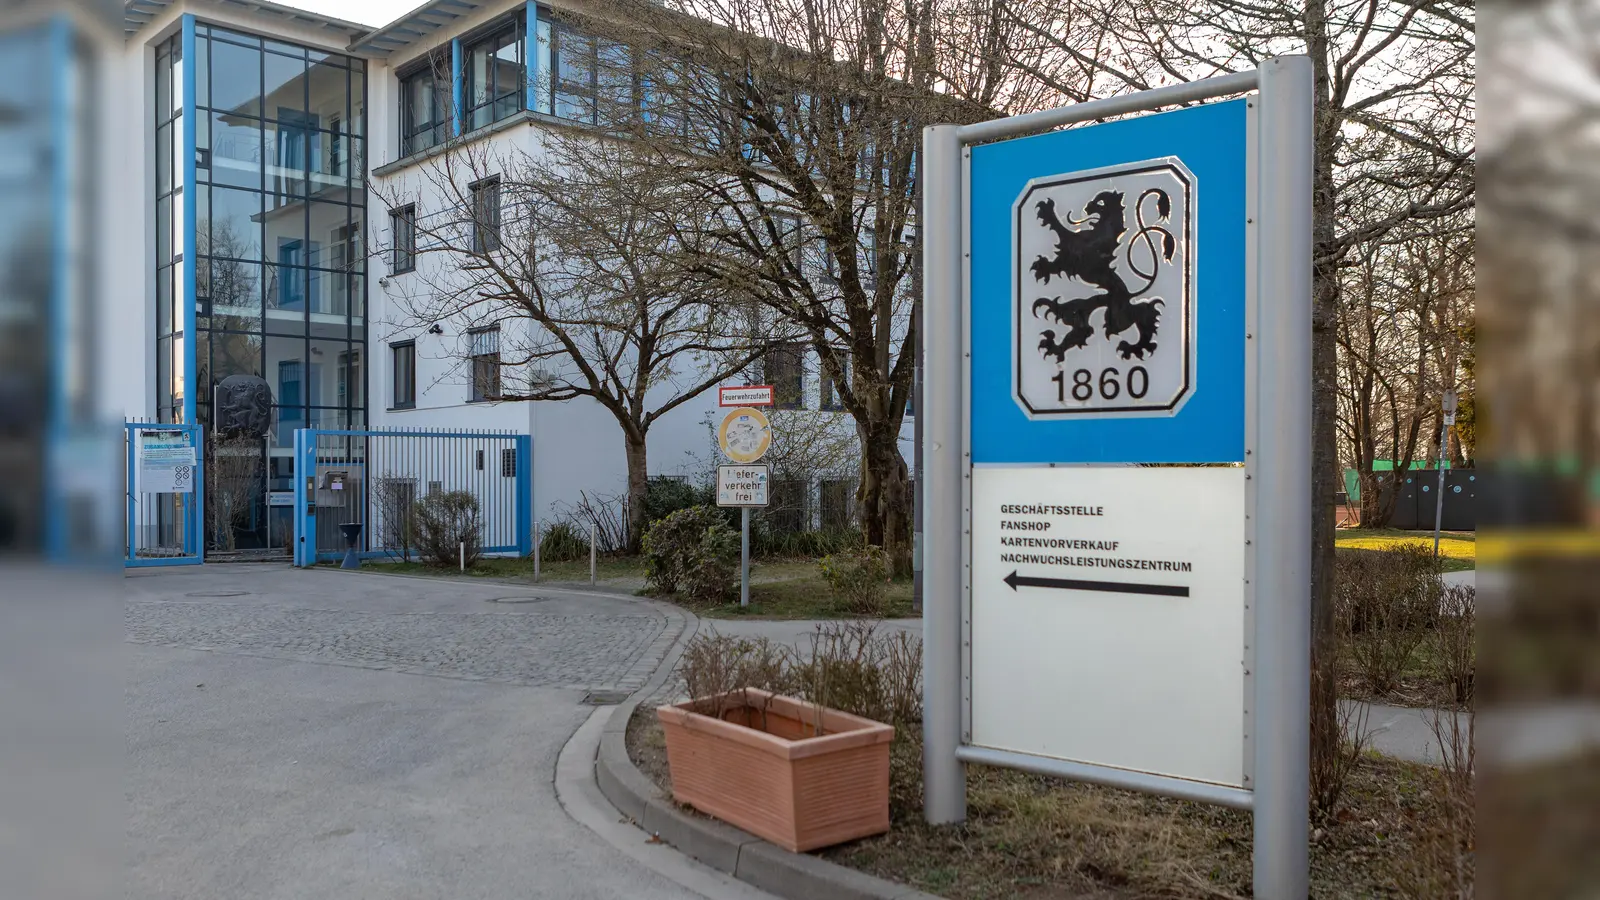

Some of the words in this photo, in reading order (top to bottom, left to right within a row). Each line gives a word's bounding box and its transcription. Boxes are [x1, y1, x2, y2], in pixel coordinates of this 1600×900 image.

[1051, 365, 1149, 402] 1860
[722, 392, 770, 401] Feuerwehrzufahrt
[725, 481, 761, 490] verkehr
[735, 492, 752, 501] frei
[1001, 502, 1104, 516] GESCHÄFTSSTELLE
[1001, 520, 1051, 532] FANSHOP
[1001, 537, 1119, 551] KARTENVORVERKAUF
[1001, 553, 1192, 572] NACHWUCHSLEISTUNGSZENTRUM
